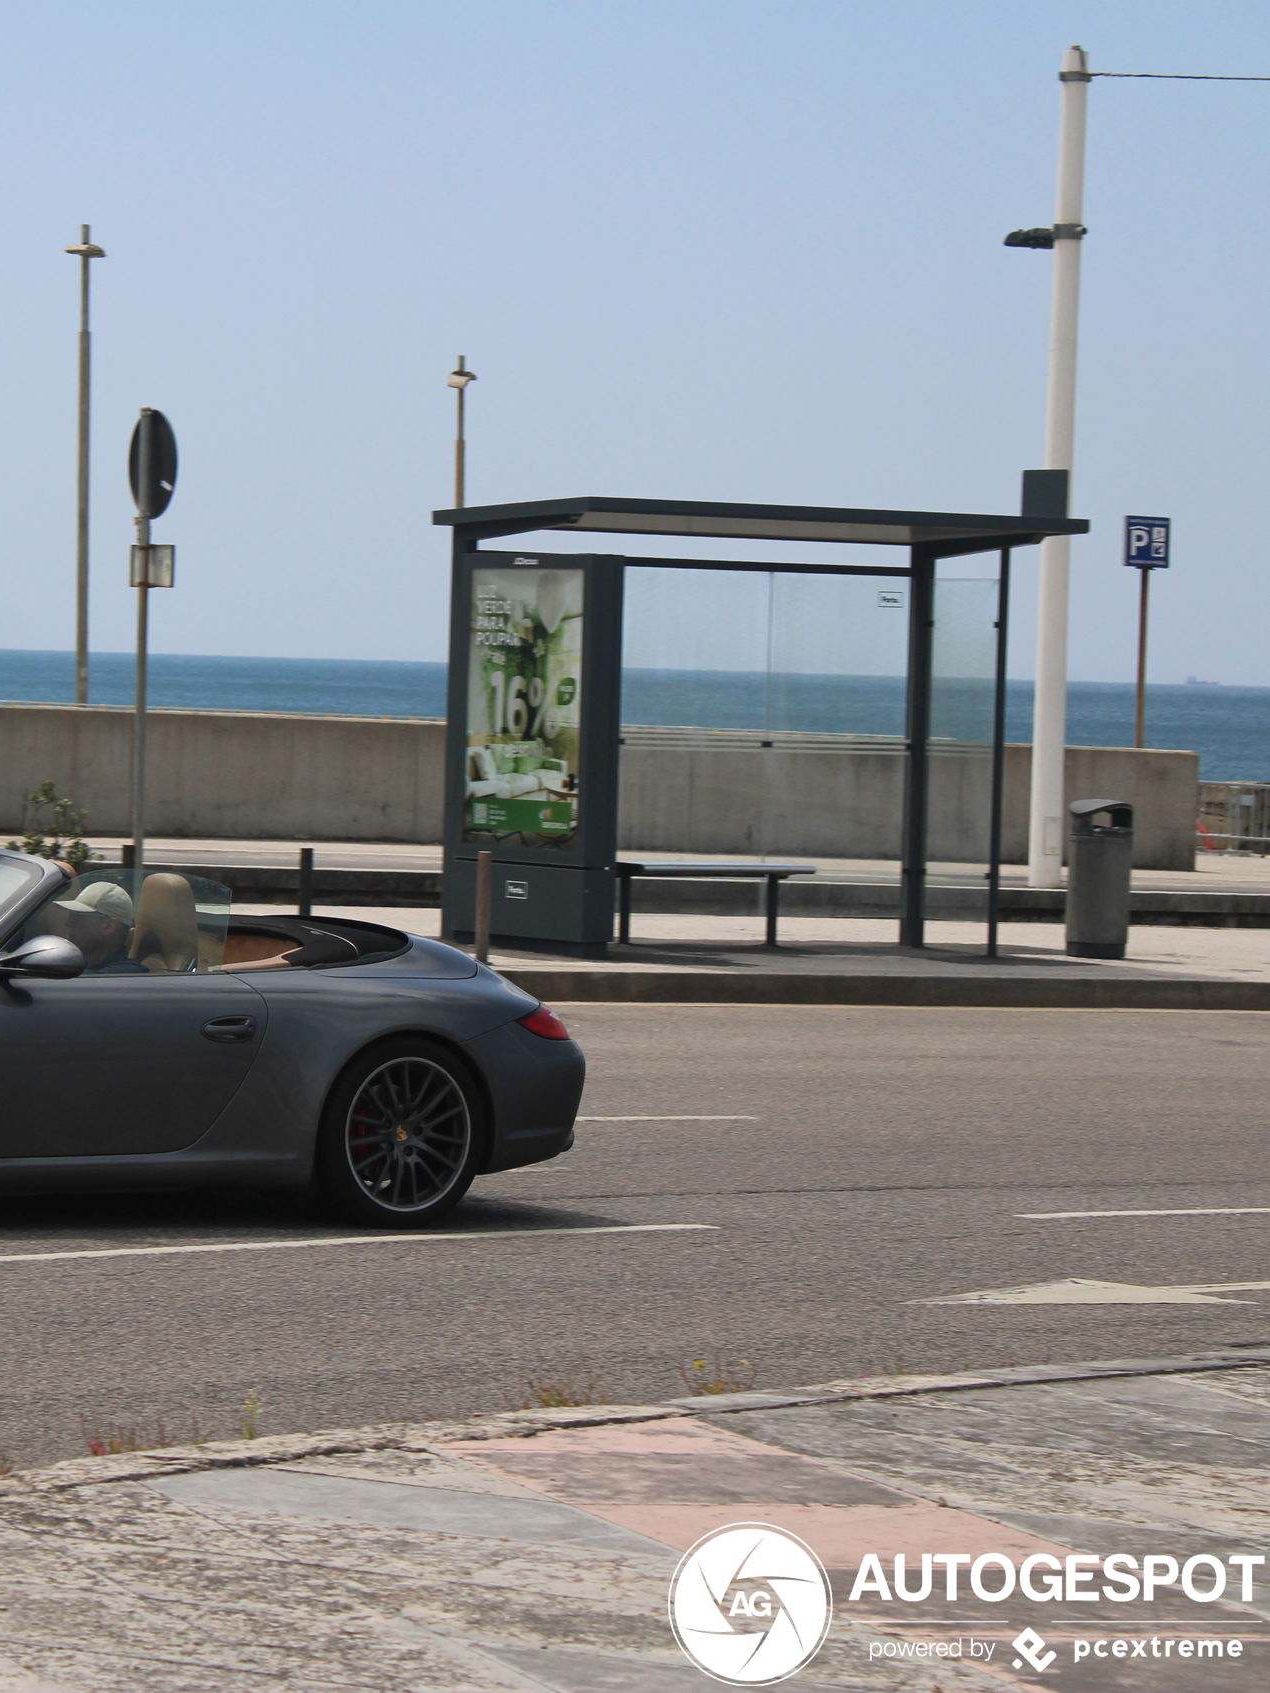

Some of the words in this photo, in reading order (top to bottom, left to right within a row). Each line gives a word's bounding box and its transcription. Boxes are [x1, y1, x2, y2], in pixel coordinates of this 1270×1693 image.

[1130, 529, 1150, 556] P
[475, 600, 513, 615] VERDE
[475, 616, 506, 630] PARA
[475, 631, 522, 647] POUPAR
[490, 670, 561, 739] 16%
